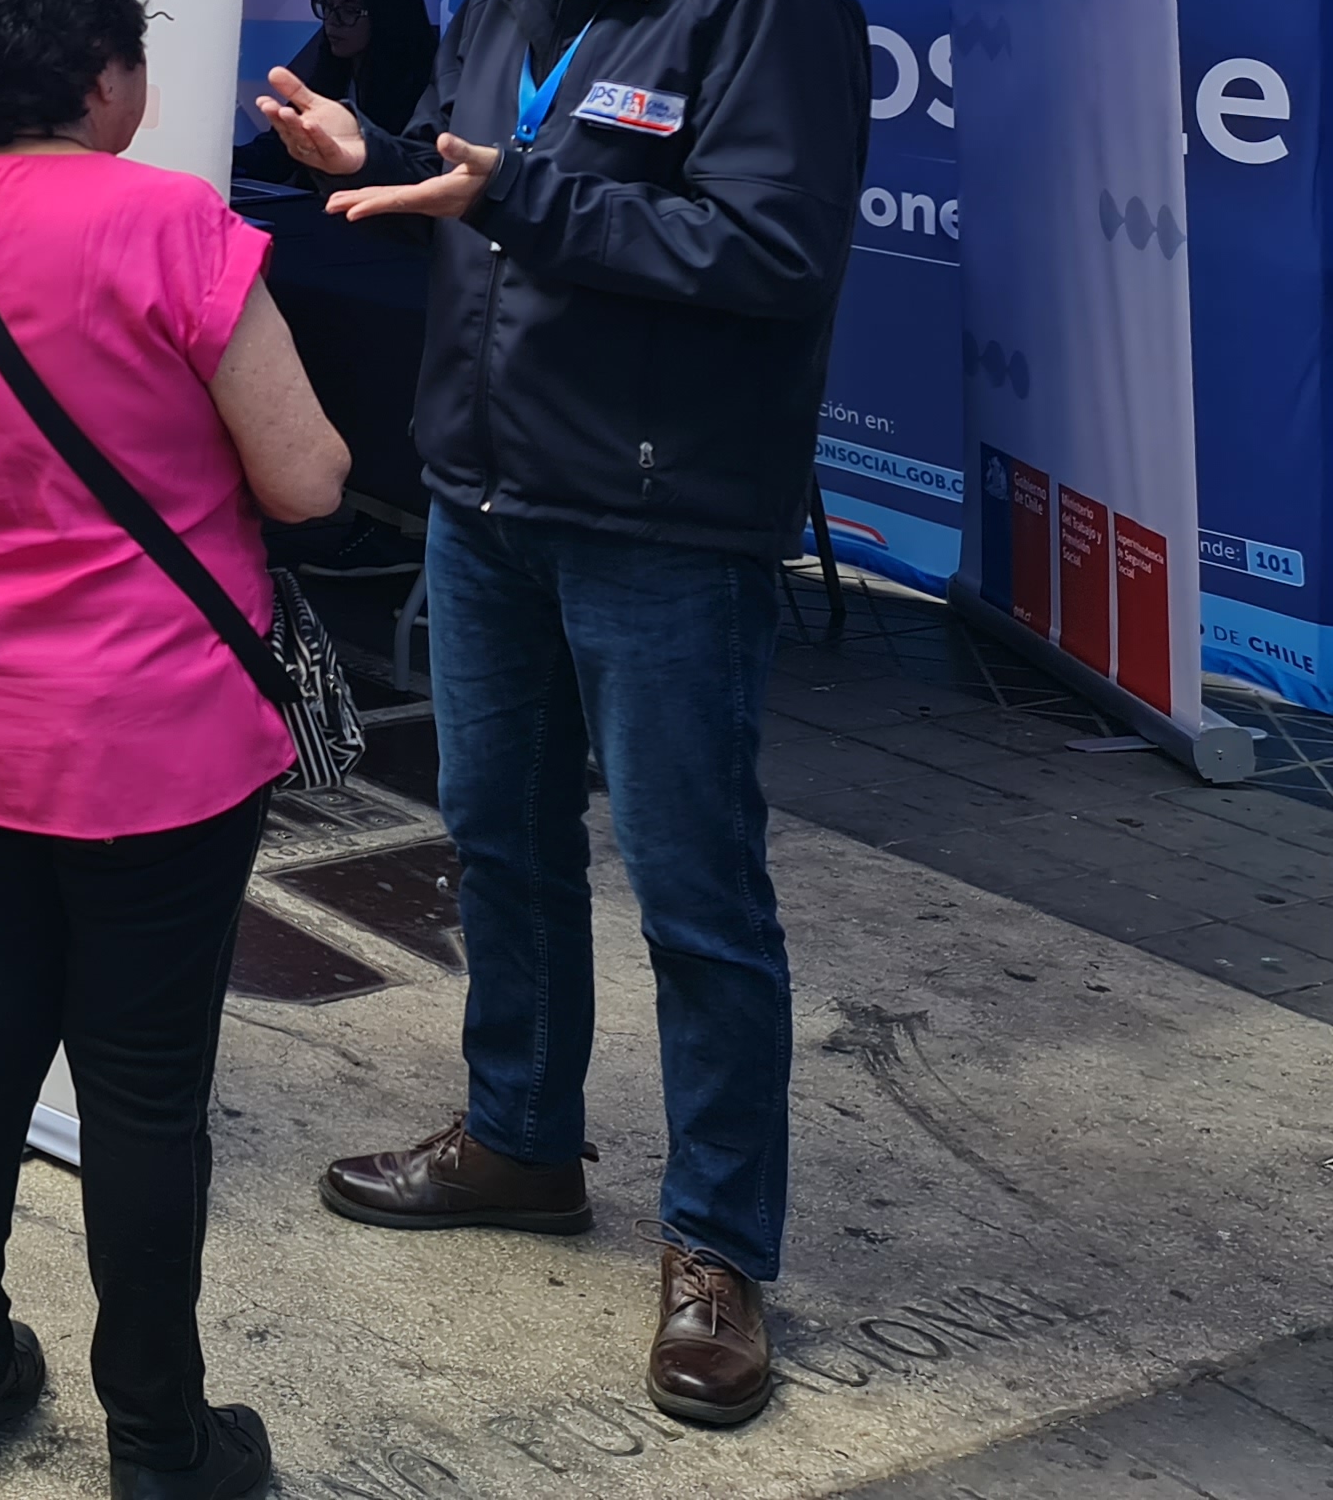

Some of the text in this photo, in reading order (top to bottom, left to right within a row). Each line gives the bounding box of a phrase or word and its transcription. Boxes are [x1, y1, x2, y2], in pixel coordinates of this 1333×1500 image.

[865, 414, 895, 434] en:
[1013, 471, 1047, 500] Gobierno
[1014, 491, 1043, 515] de Chile
[1061, 492, 1094, 519] Ministerio
[1062, 512, 1102, 545] del Trabajo y
[1062, 546, 1082, 567] Social
[1124, 549, 1151, 573] Seguridad
[1255, 551, 1294, 576] 101
[1118, 561, 1135, 579] Social
[1213, 625, 1315, 675] DE CHILE
